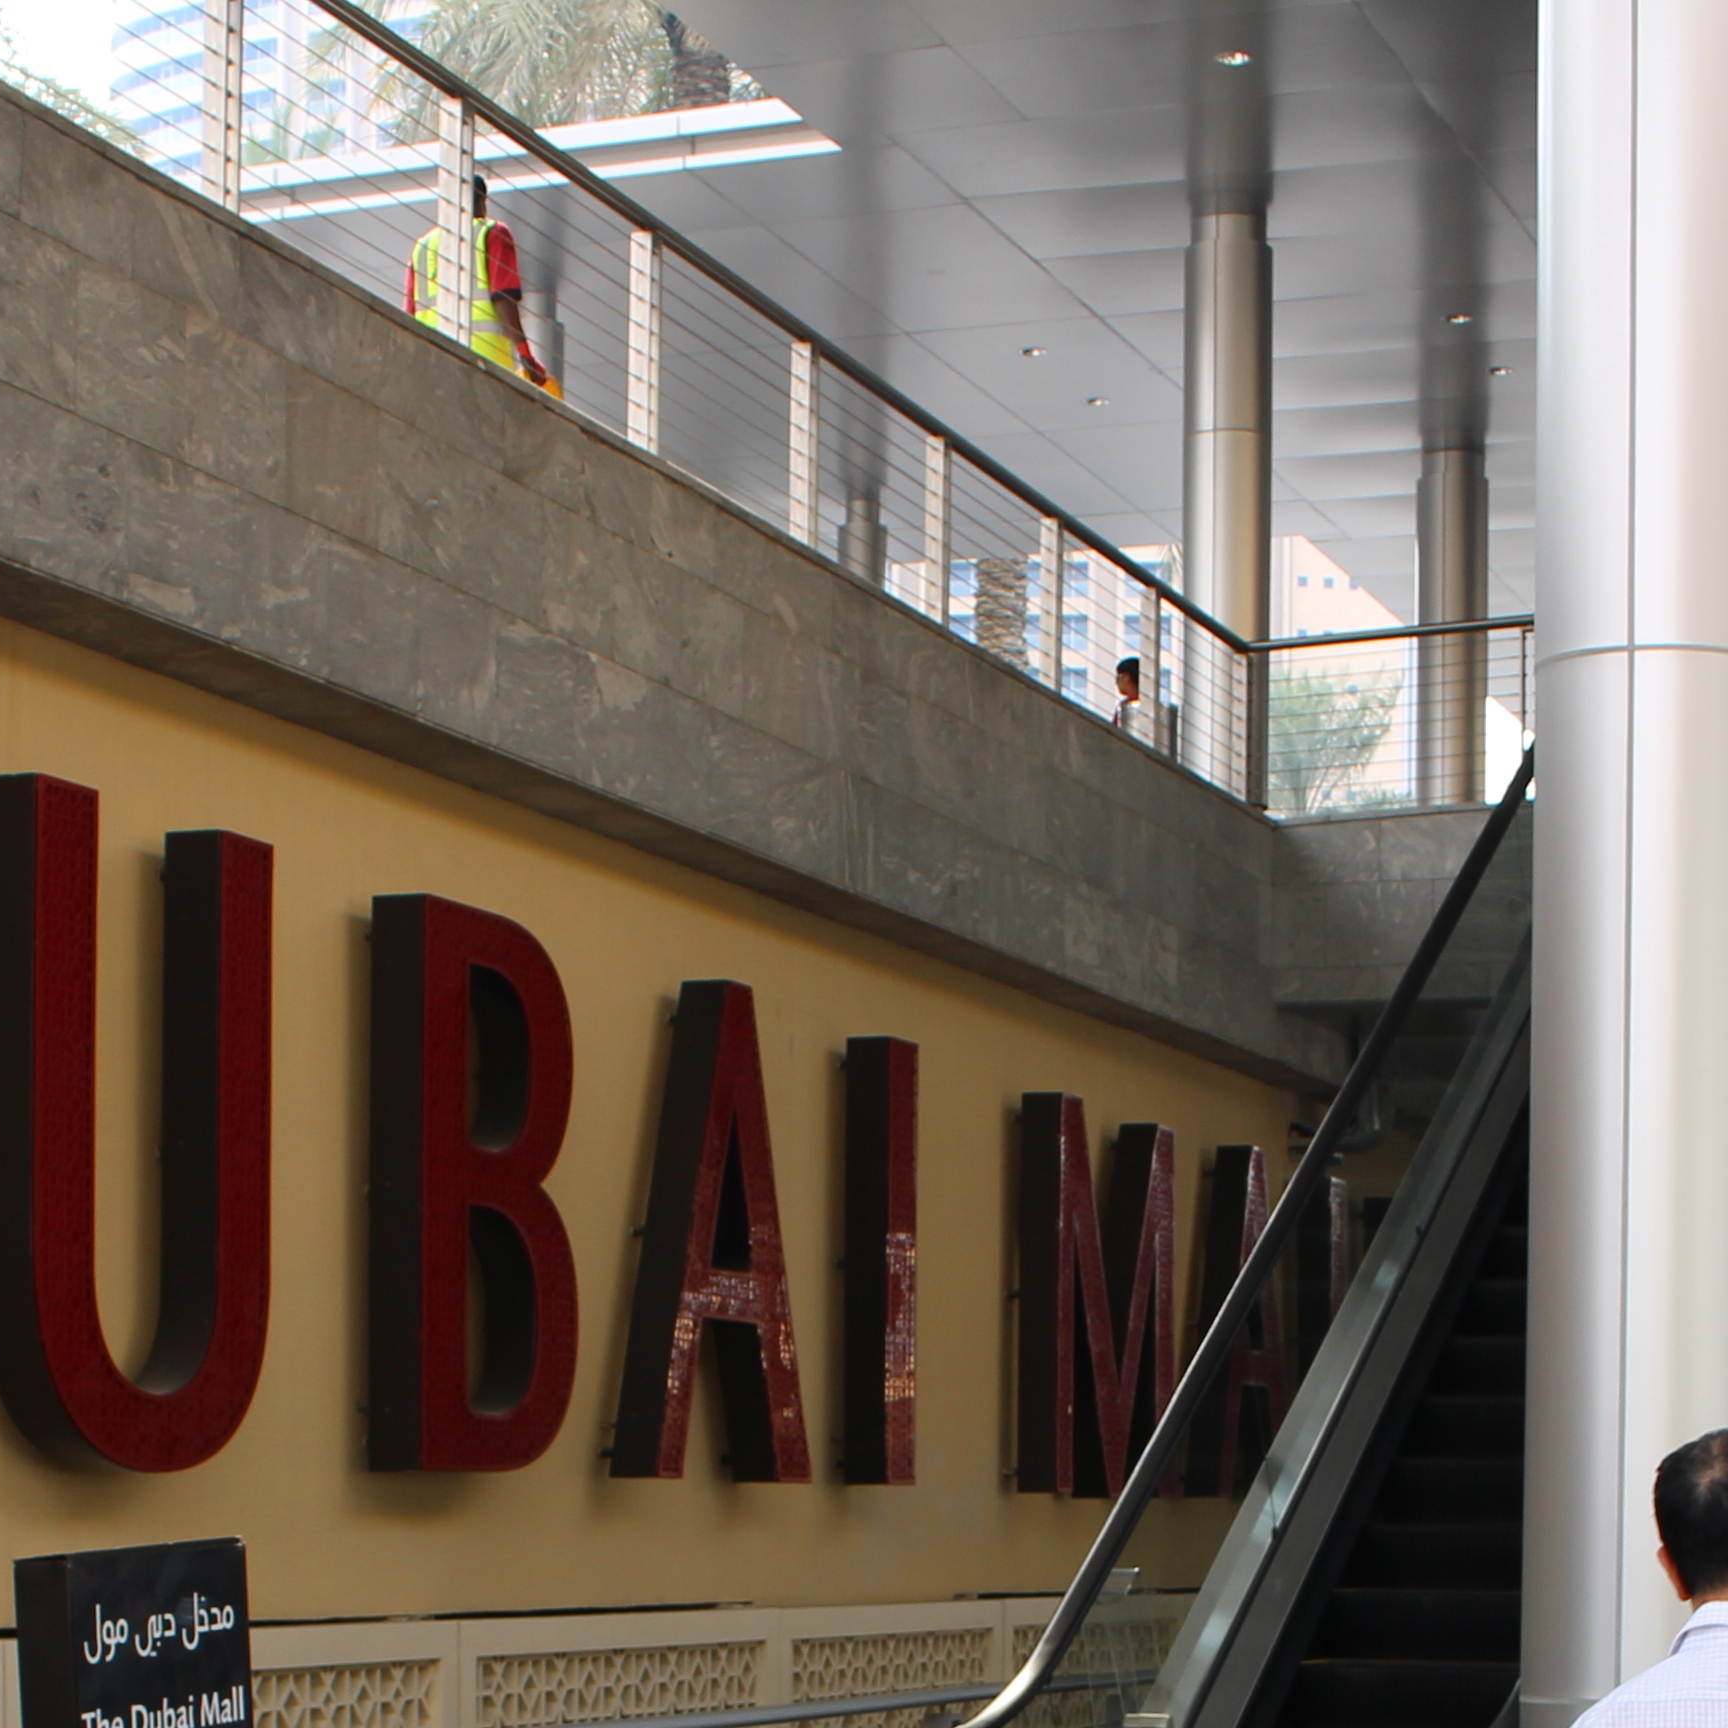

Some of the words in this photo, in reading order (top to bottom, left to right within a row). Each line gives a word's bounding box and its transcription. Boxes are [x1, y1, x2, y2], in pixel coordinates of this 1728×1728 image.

[83, 1603, 129, 1664] مول
[134, 1612, 176, 1657] دبي
[181, 1591, 235, 1650] مدخل
[200, 1685, 245, 1727] Mall
